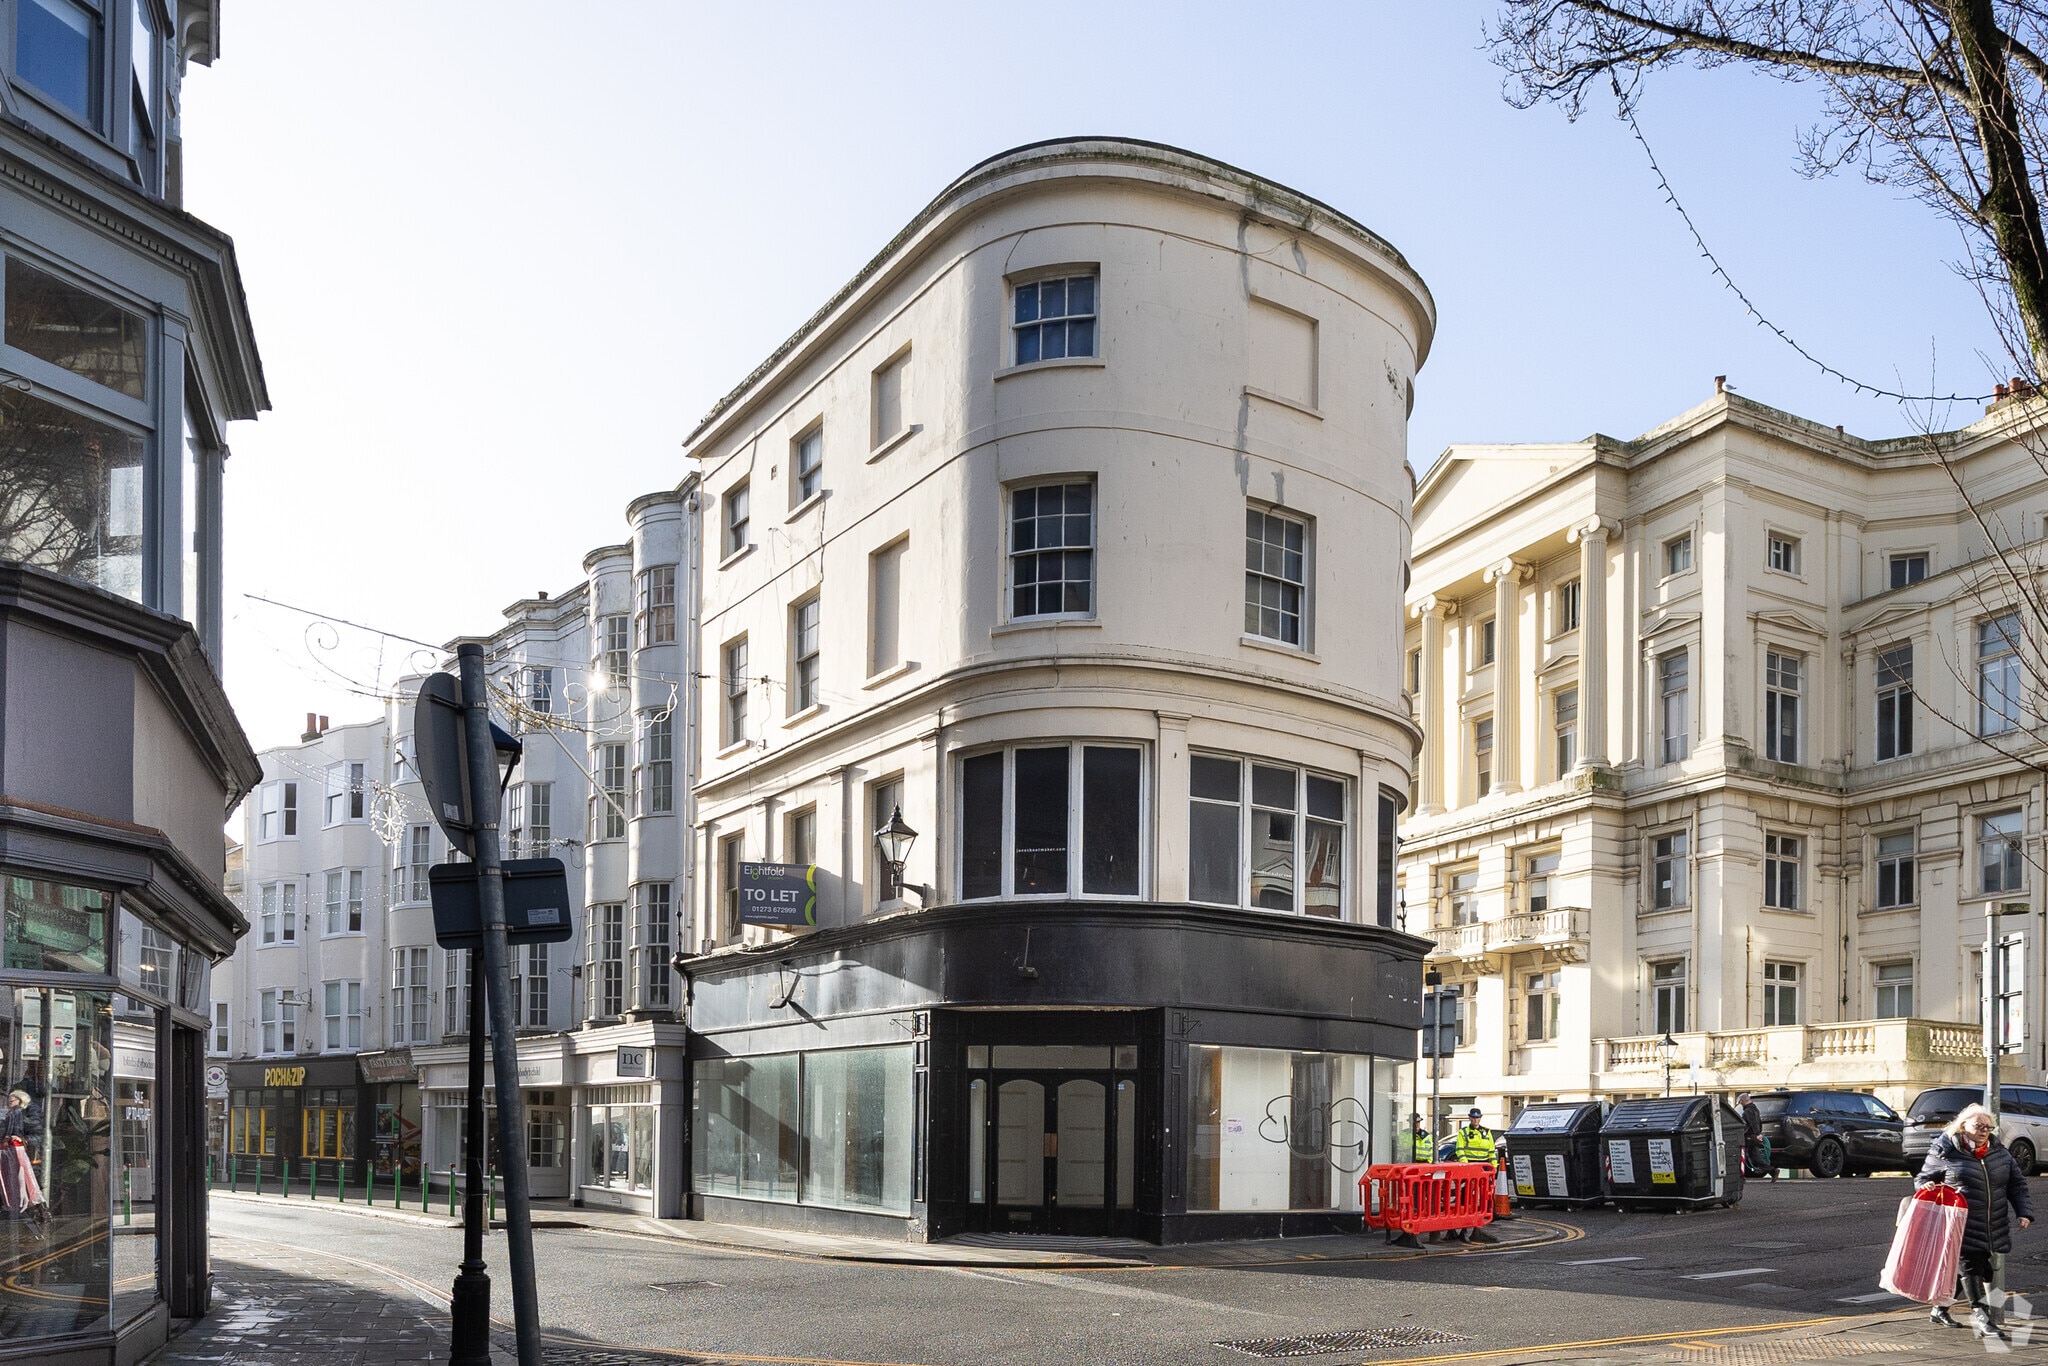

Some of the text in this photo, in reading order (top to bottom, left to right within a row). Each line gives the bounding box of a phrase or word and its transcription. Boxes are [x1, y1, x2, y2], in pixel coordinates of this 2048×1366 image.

[744, 888, 799, 903] TO LET
[751, 905, 772, 913] 01273
[622, 1053, 643, 1066] nc
